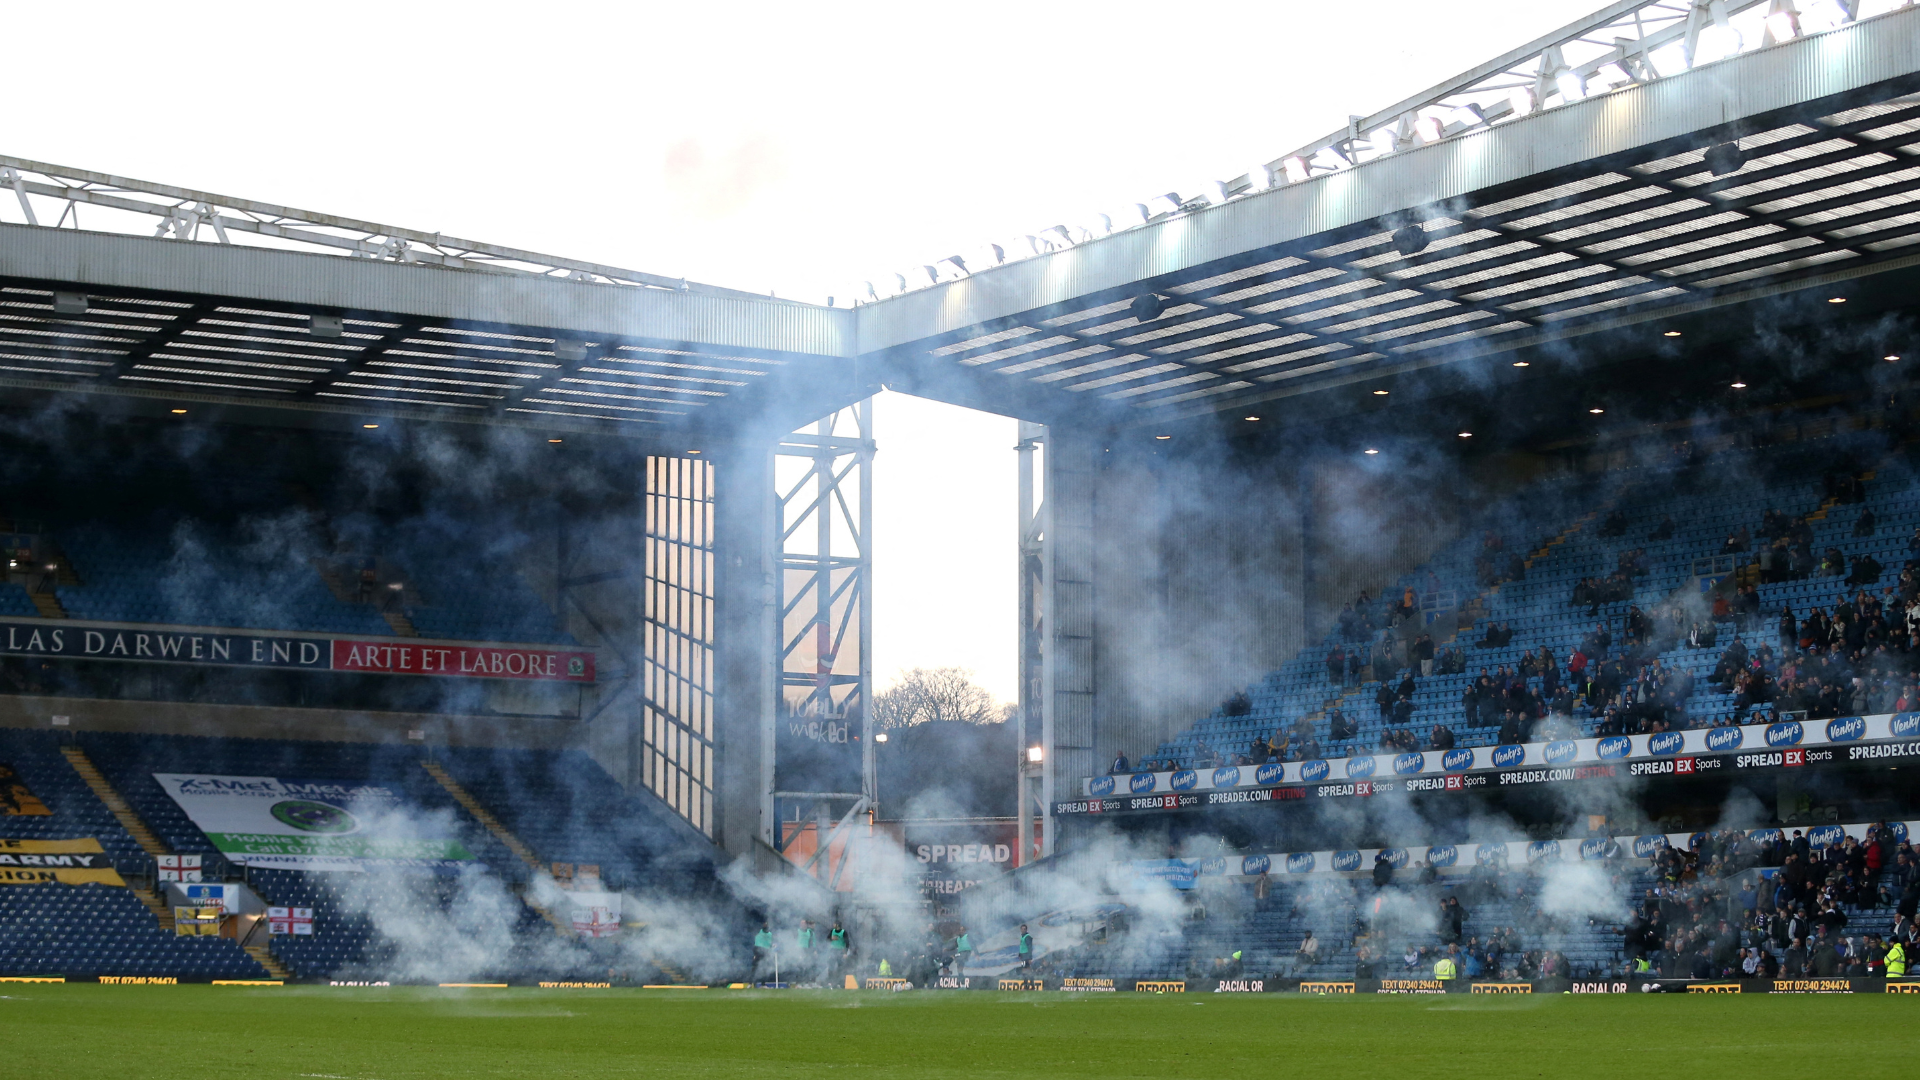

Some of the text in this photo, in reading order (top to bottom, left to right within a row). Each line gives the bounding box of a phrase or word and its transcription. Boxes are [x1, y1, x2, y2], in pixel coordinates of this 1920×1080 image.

[8, 627, 320, 664] LAS DARWEN END
[345, 645, 557, 676] ARTE ET LABORE
[1769, 722, 1800, 743] Venky's
[1831, 718, 1862, 739] Venky's
[1652, 733, 1680, 753] Venky's
[1710, 728, 1739, 748] Venky's
[1495, 745, 1521, 764] Venky's
[1546, 741, 1574, 760] Venky's
[1600, 738, 1628, 757] Venky's
[1395, 753, 1421, 770] Venky's
[1445, 749, 1471, 767] Venky's
[1737, 750, 1833, 768] SPREAD EX Sports
[1258, 765, 1281, 781] Venky's
[1302, 761, 1327, 777] Venky's
[1348, 758, 1373, 776] Venky's
[1630, 758, 1721, 775] SPREAD EX Sports
[1131, 775, 1153, 790] Venky's
[1172, 770, 1195, 787] Venky's
[1215, 769, 1237, 784] Venky's
[1406, 775, 1487, 791] SPREAD EX Sports
[173, 778, 278, 792] X-Met
[180, 788, 230, 797] Mobile
[1091, 778, 1112, 793] Venky's
[1318, 782, 1393, 798] SPREAD EX Sports
[1057, 800, 1121, 813] SPREAD EX Sports
[1131, 795, 1198, 809] SPREAD EX Sports
[223, 834, 294, 845] Mobile
[1809, 827, 1841, 846] Venky's
[245, 843, 283, 854] Call
[917, 844, 1010, 863] SPREAD
[1429, 847, 1454, 864] Venky's
[1530, 842, 1557, 859] Venky's
[0, 854, 94, 867] ARMY
[1245, 857, 1268, 871] Venky's
[1289, 855, 1312, 871] Venky's
[1334, 852, 1358, 869] Venky's
[1064, 978, 1077, 987] TEXT
[1220, 981, 1263, 992] RACIAL OR
[1381, 980, 1443, 989] TEXT 07340 294474
[1572, 983, 1627, 993] RACIAL OR
[1773, 981, 1850, 990] TEXT 07340 294474
